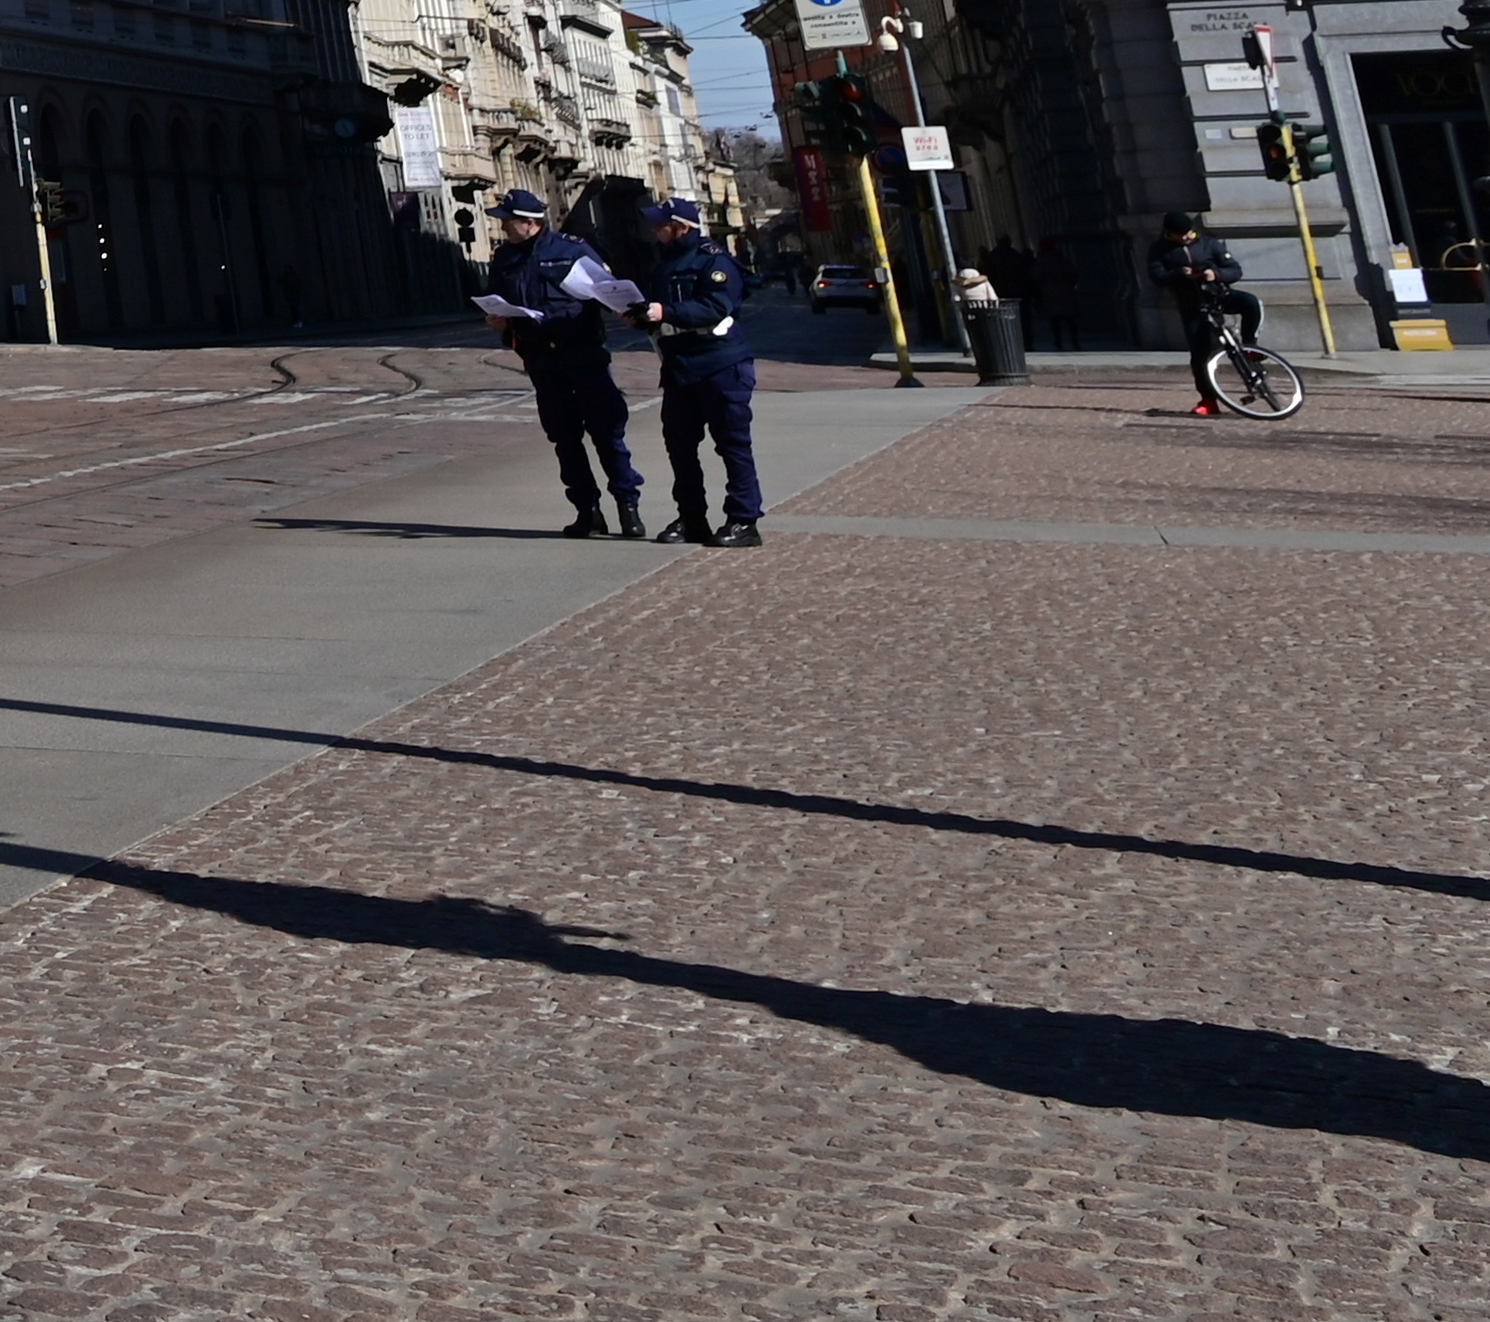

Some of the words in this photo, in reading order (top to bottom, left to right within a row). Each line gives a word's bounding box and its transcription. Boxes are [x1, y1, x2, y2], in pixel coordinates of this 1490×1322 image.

[1206, 12, 1249, 21] PIAZZA
[1191, 23, 1228, 32] DELLA
[399, 124, 432, 133] OFFICES
[403, 132, 414, 140] TO
[416, 132, 430, 140] LET
